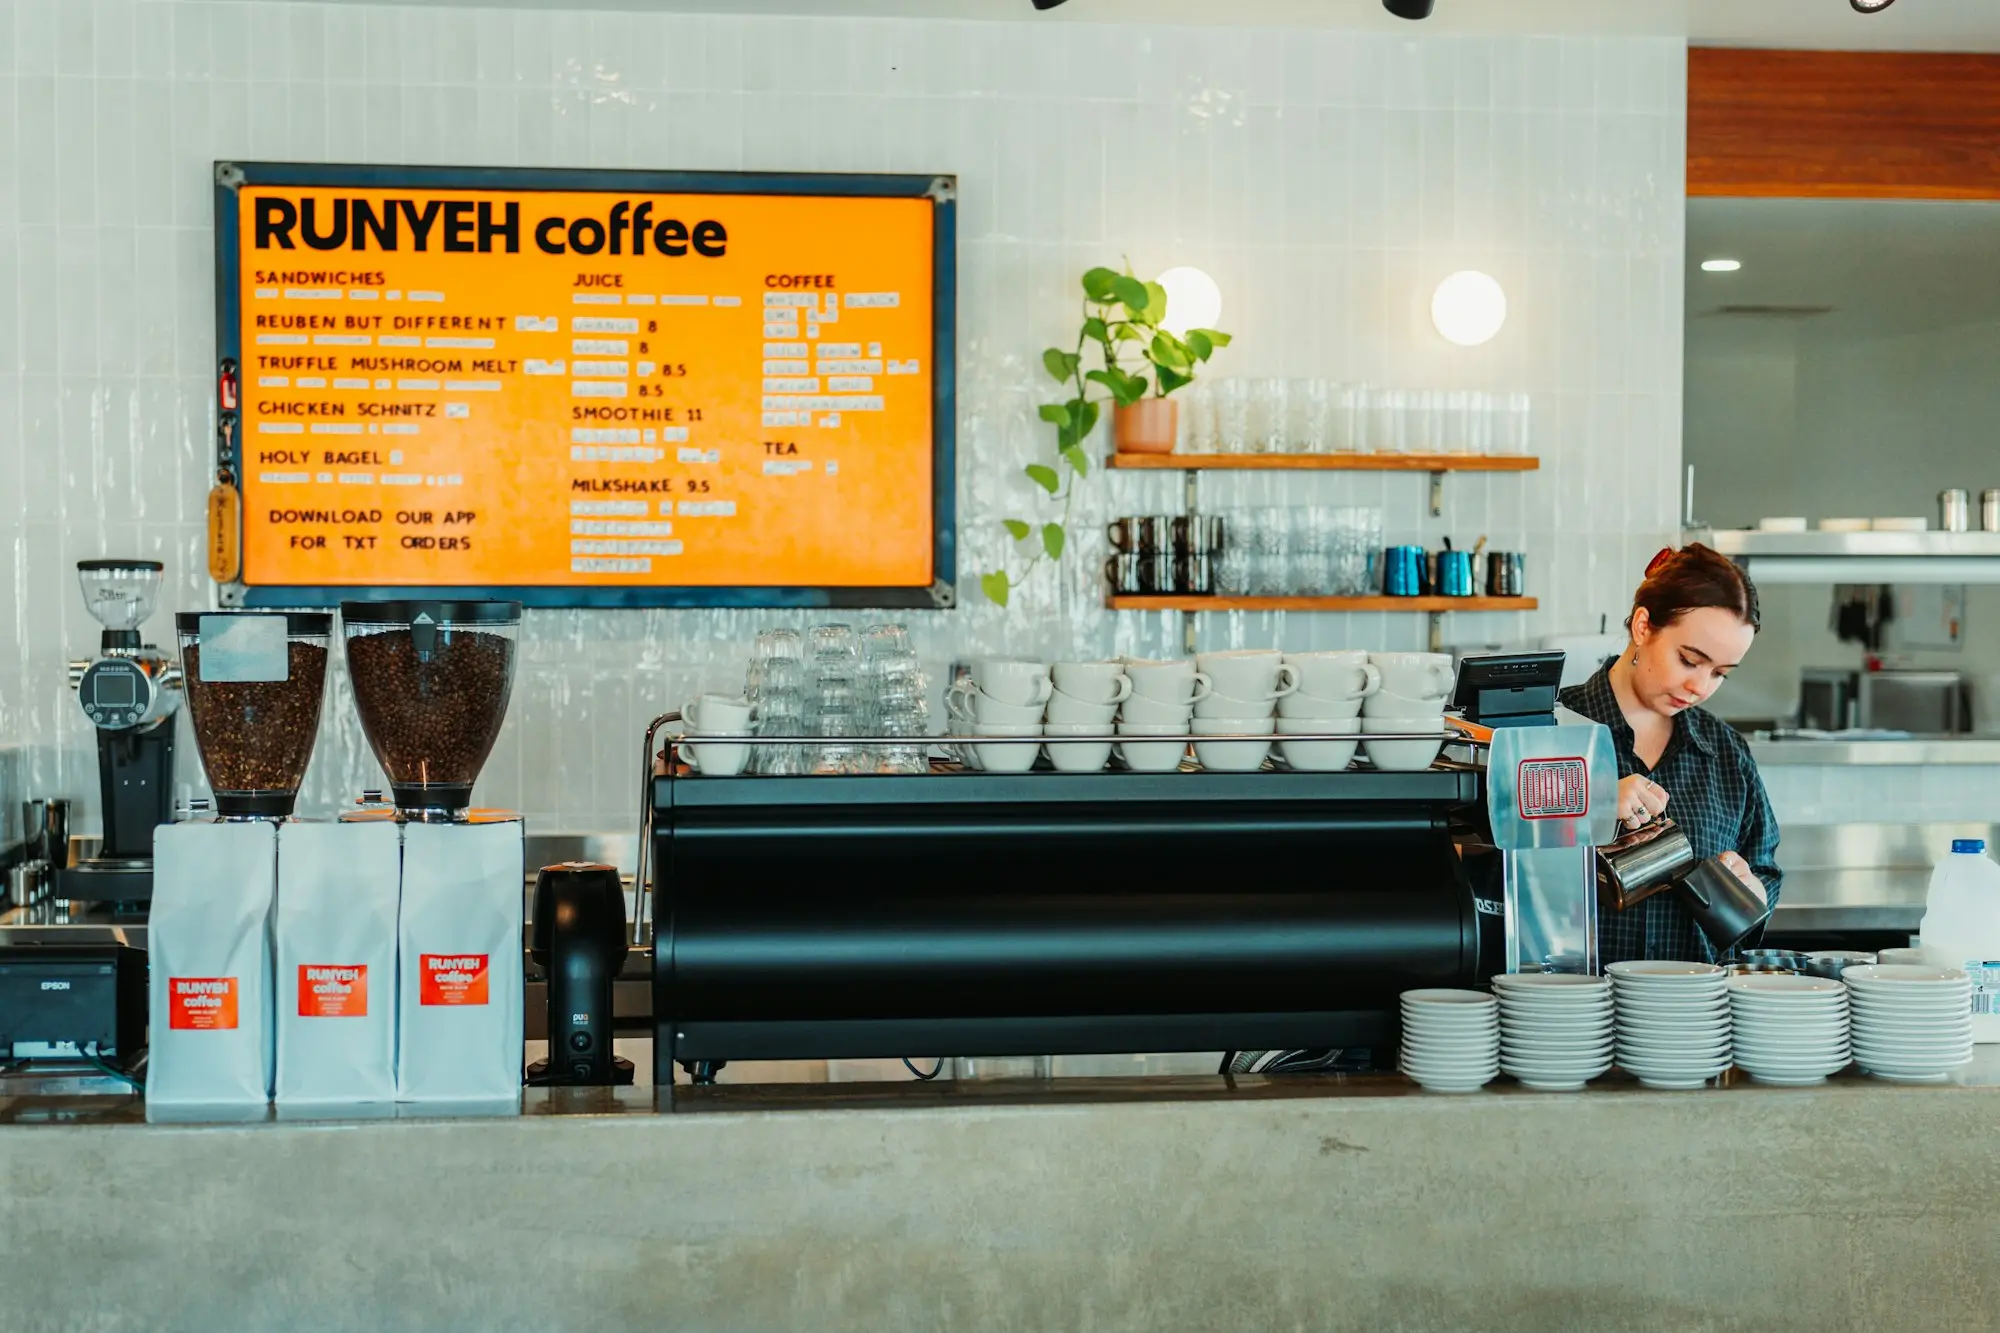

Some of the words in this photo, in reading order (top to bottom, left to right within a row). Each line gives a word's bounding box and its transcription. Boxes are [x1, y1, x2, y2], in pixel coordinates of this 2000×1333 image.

[254, 196, 520, 254] RUNYEH
[534, 199, 728, 259] coffee
[255, 270, 385, 285] SANDWICHES
[573, 274, 622, 288] JUICE
[765, 274, 834, 288] COFFEE
[256, 314, 336, 329] REUBEN
[345, 315, 382, 329] BUT
[393, 316, 507, 330] DIFFERENT
[648, 320, 657, 333] 8
[639, 341, 649, 354] 8
[258, 355, 336, 370] TRUFFLE
[351, 357, 462, 373] MUSHROOM
[472, 360, 518, 373] MELT
[258, 401, 345, 416] CHICKEN
[357, 402, 436, 417] SCHNITZ
[573, 406, 673, 421] SMOOTHIE
[687, 408, 702, 421] 11
[764, 441, 798, 455] TEA
[260, 450, 310, 464] HOLY
[324, 451, 382, 465] BAGEL
[571, 478, 670, 493] MILKSHAKE
[269, 509, 383, 524] DOWNLOAD
[395, 511, 433, 525] OUR
[443, 510, 476, 524] APP
[290, 535, 326, 550] FOR
[343, 535, 377, 550] TXT
[400, 535, 471, 550] ORDERS
[1524, 767, 1581, 808] WALLY
[428, 958, 480, 970] RUNYEH
[306, 968, 359, 981] RUNYEH
[434, 970, 474, 983] coffee
[41, 982, 70, 990] EPSON
[177, 982, 229, 994] RUNYEH
[312, 981, 352, 994] coffee
[183, 995, 222, 1007] coffee
